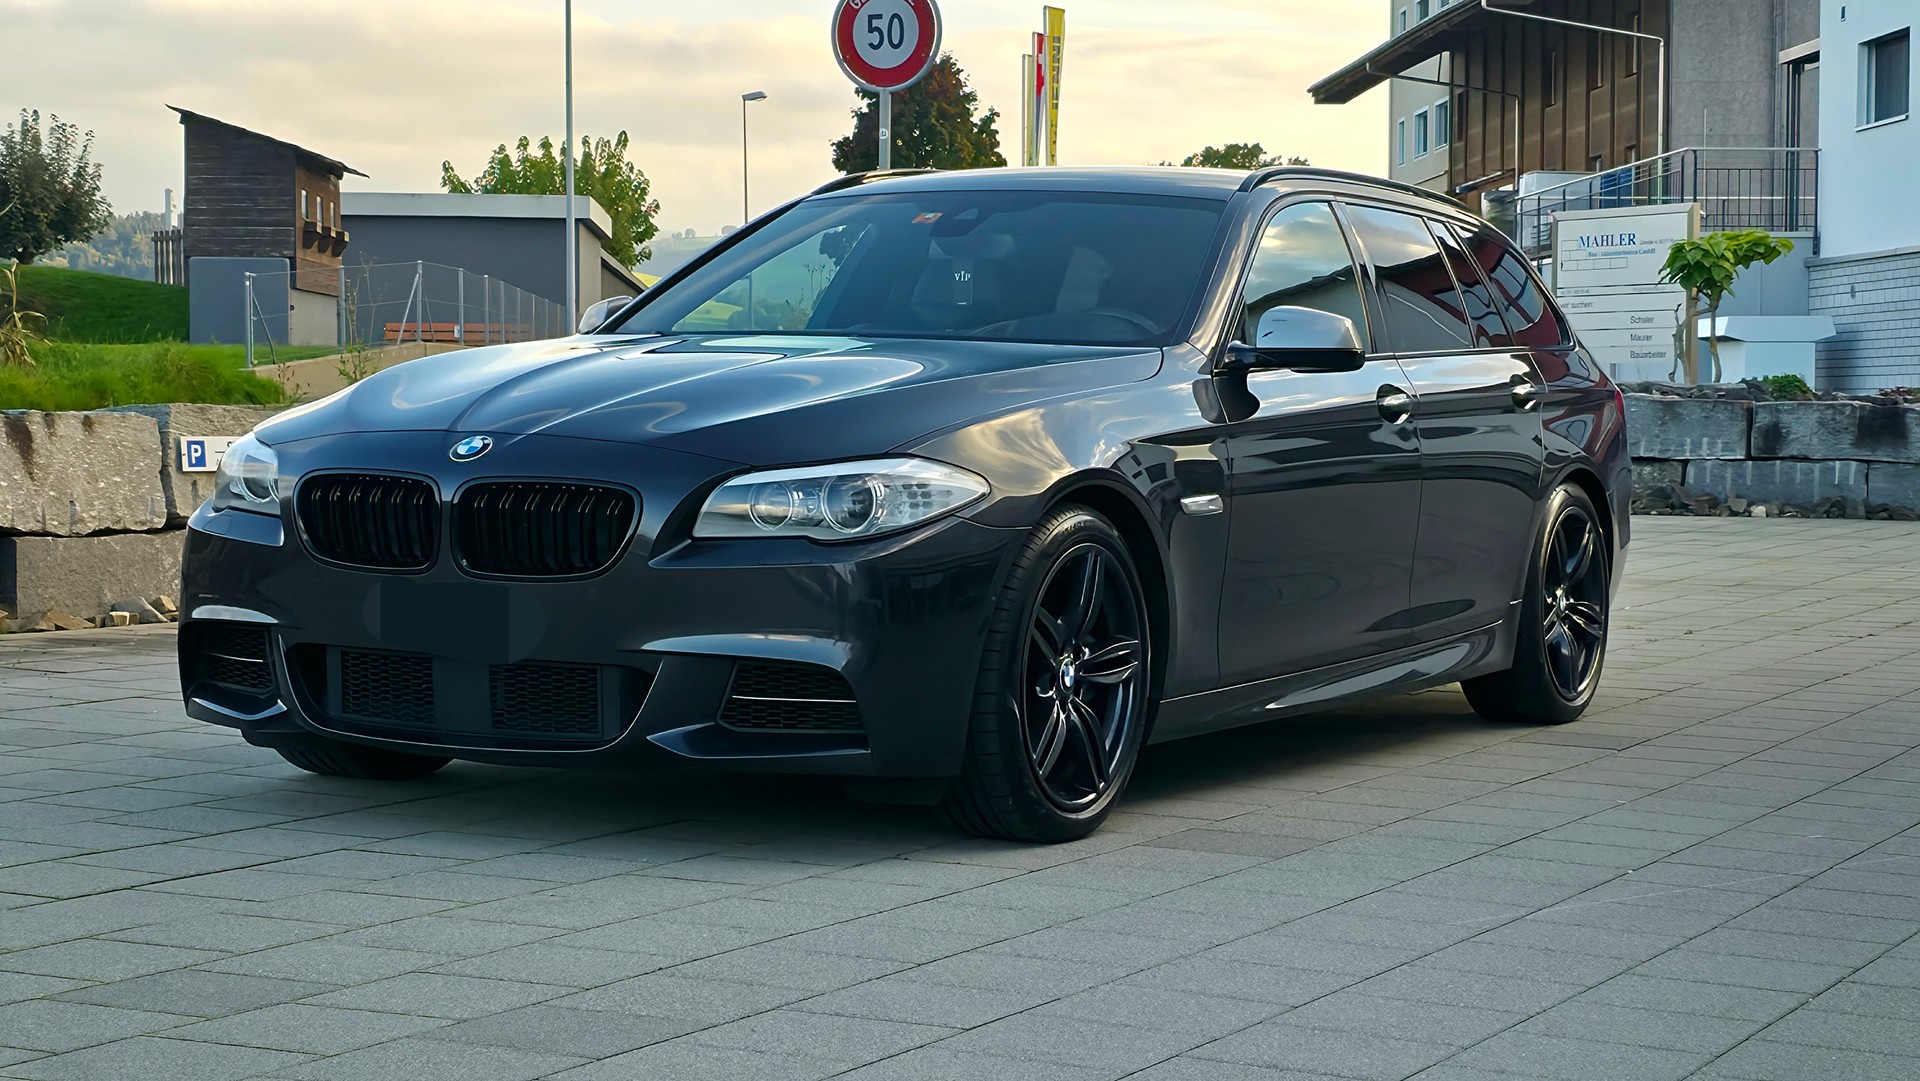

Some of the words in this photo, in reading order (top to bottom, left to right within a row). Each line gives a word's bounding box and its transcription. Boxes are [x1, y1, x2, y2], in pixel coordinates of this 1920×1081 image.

[867, 13, 904, 50] 50
[1579, 233, 1636, 248] MAHLER
[1630, 333, 1653, 341] Maurer
[1630, 351, 1667, 359] Bauarbeiter
[190, 444, 202, 464] P
